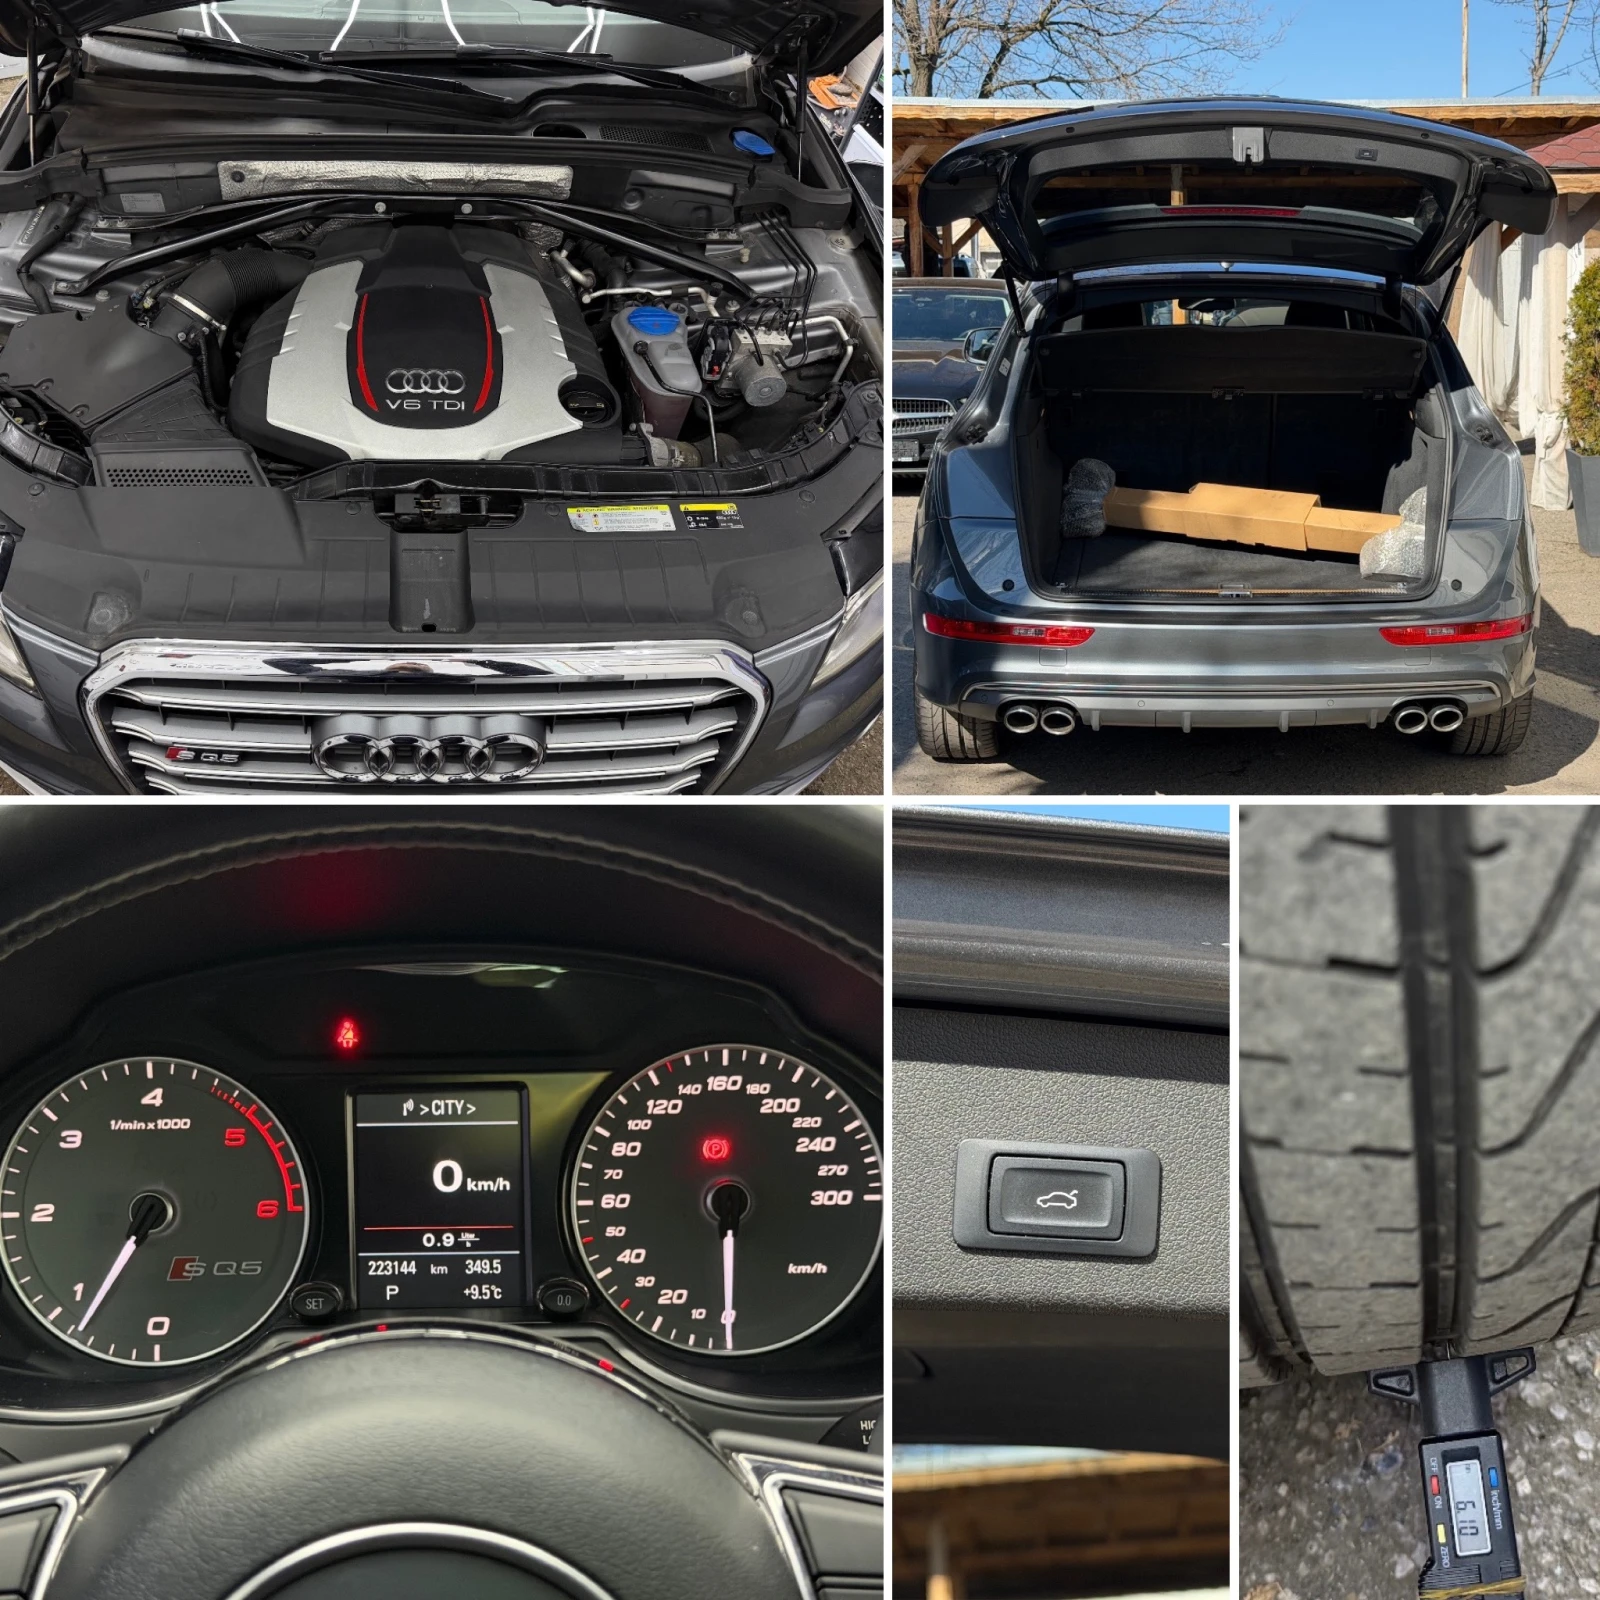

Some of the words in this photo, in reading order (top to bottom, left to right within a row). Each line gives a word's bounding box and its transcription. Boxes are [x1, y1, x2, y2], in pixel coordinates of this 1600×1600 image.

[386, 400, 421, 410] V6
[428, 400, 465, 411] TDI
[678, 1084, 702, 1095] 140
[706, 1075, 742, 1091] 160
[746, 1083, 771, 1095] 180
[141, 1088, 163, 1107] 4
[646, 1099, 683, 1115] 120
[760, 1098, 800, 1113] 200
[627, 1119, 652, 1131] 100
[792, 1117, 822, 1128] 220
[59, 1130, 83, 1149] 3
[224, 1129, 246, 1147] 5
[795, 1137, 837, 1153] 240
[611, 1141, 642, 1157] 80
[432, 1160, 464, 1193] 0
[466, 1177, 511, 1192] km/h
[603, 1169, 623, 1180] 70
[817, 1165, 848, 1176] 270
[600, 1194, 631, 1209] 60
[810, 1190, 853, 1205] 300
[30, 1203, 55, 1222] 2
[256, 1201, 279, 1219] 6
[605, 1226, 626, 1237] 50
[422, 1233, 455, 1247] 0.9
[616, 1248, 646, 1264] 40
[368, 1260, 417, 1276] 223144
[430, 1264, 448, 1275] km
[465, 1259, 501, 1275] 349.5
[787, 1263, 827, 1274] km/h
[634, 1276, 655, 1287] 30
[73, 1282, 84, 1301] 1
[386, 1285, 399, 1300] P
[657, 1289, 688, 1304] 20
[305, 1298, 325, 1310] SET
[556, 1296, 572, 1307] 0.0
[691, 1308, 706, 1320] 10
[147, 1316, 170, 1336] 0
[1429, 1457, 1438, 1472] OFF
[1434, 1495, 1443, 1509] ON
[1456, 1500, 1479, 1536] 6.10
[1441, 1546, 1451, 1568] ZERO
